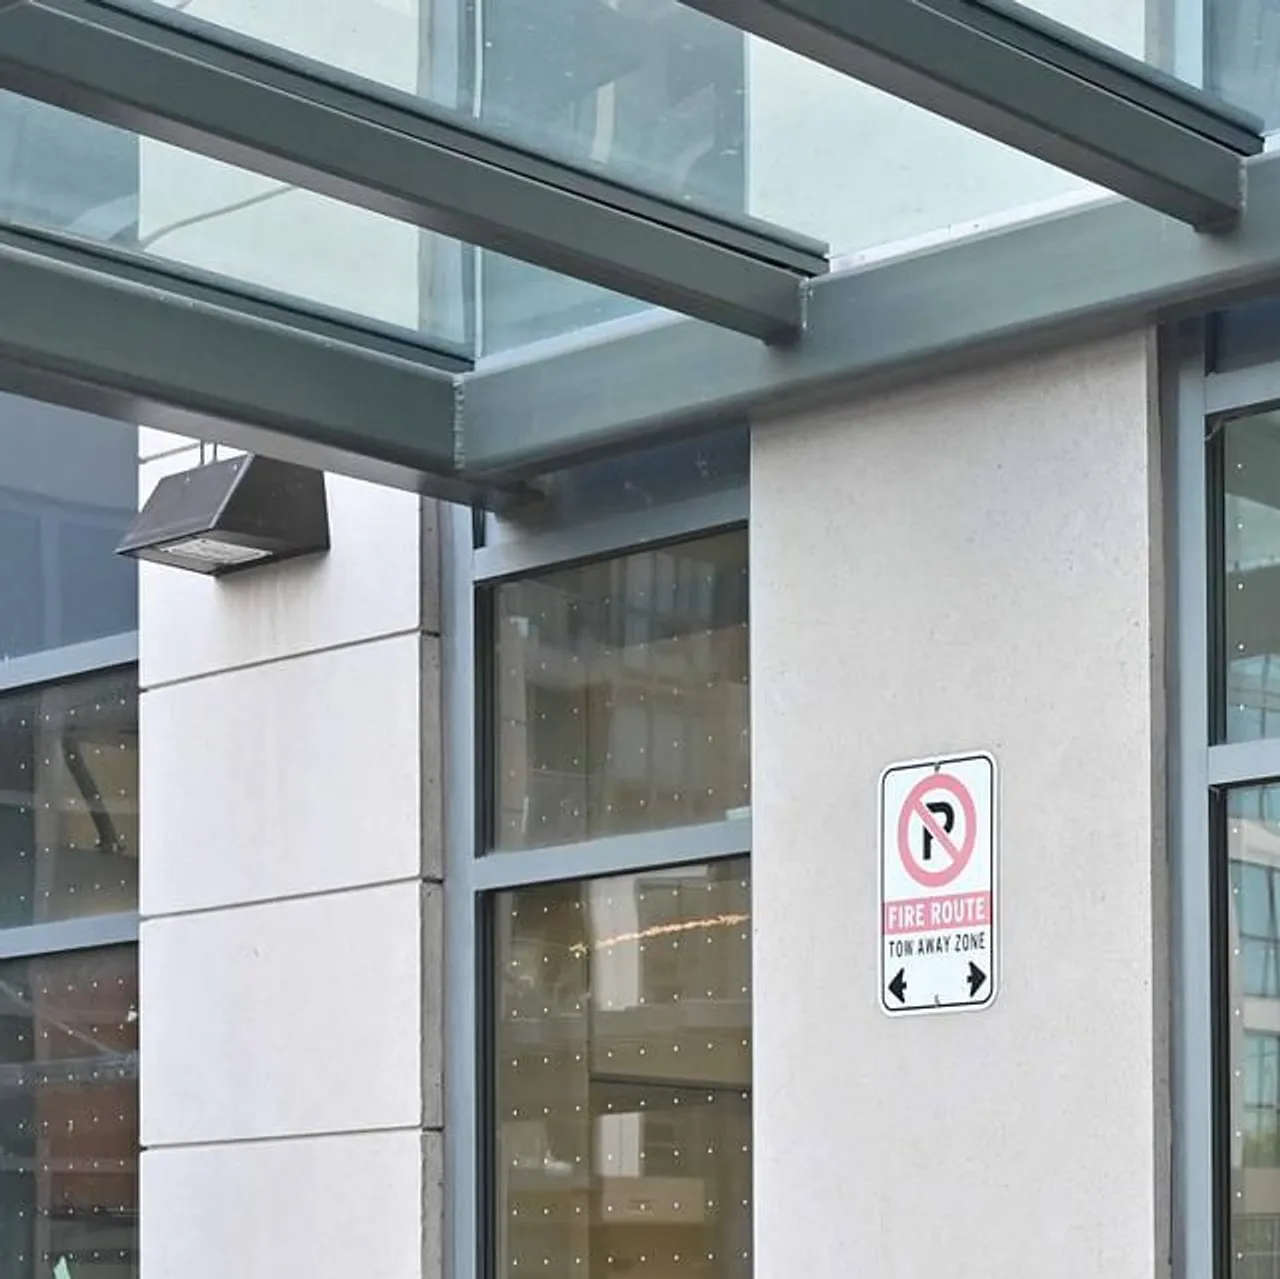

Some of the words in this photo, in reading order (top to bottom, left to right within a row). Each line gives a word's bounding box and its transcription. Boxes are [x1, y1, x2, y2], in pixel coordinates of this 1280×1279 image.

[887, 903, 926, 929] FIRE
[931, 897, 986, 925] ROUTE
[889, 939, 915, 958] TOW
[918, 935, 952, 956] AWAY
[954, 932, 987, 952] ZONE
